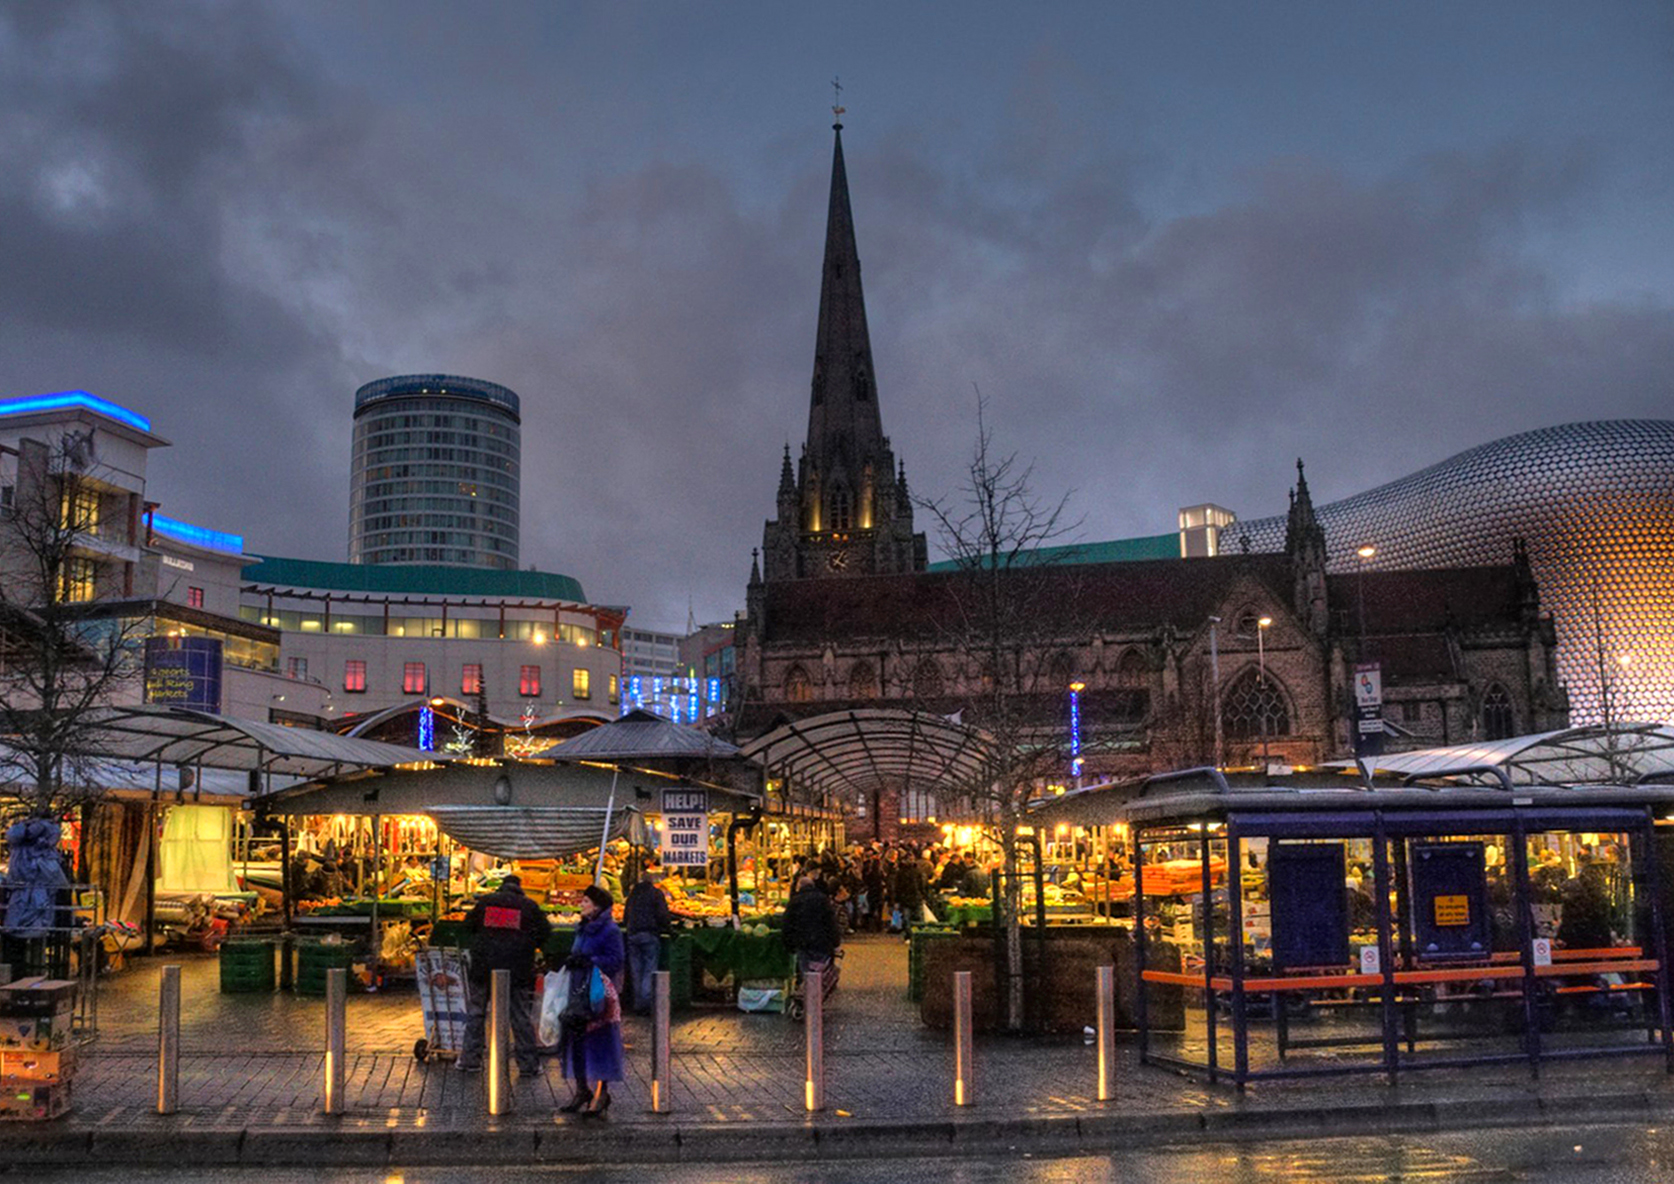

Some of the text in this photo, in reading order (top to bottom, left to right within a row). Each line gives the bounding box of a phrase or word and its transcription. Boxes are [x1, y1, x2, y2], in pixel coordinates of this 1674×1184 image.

[665, 794, 704, 809] HELP!
[668, 817, 701, 828] SAVE
[671, 834, 698, 845] OUR
[663, 851, 706, 864] MARKETS
